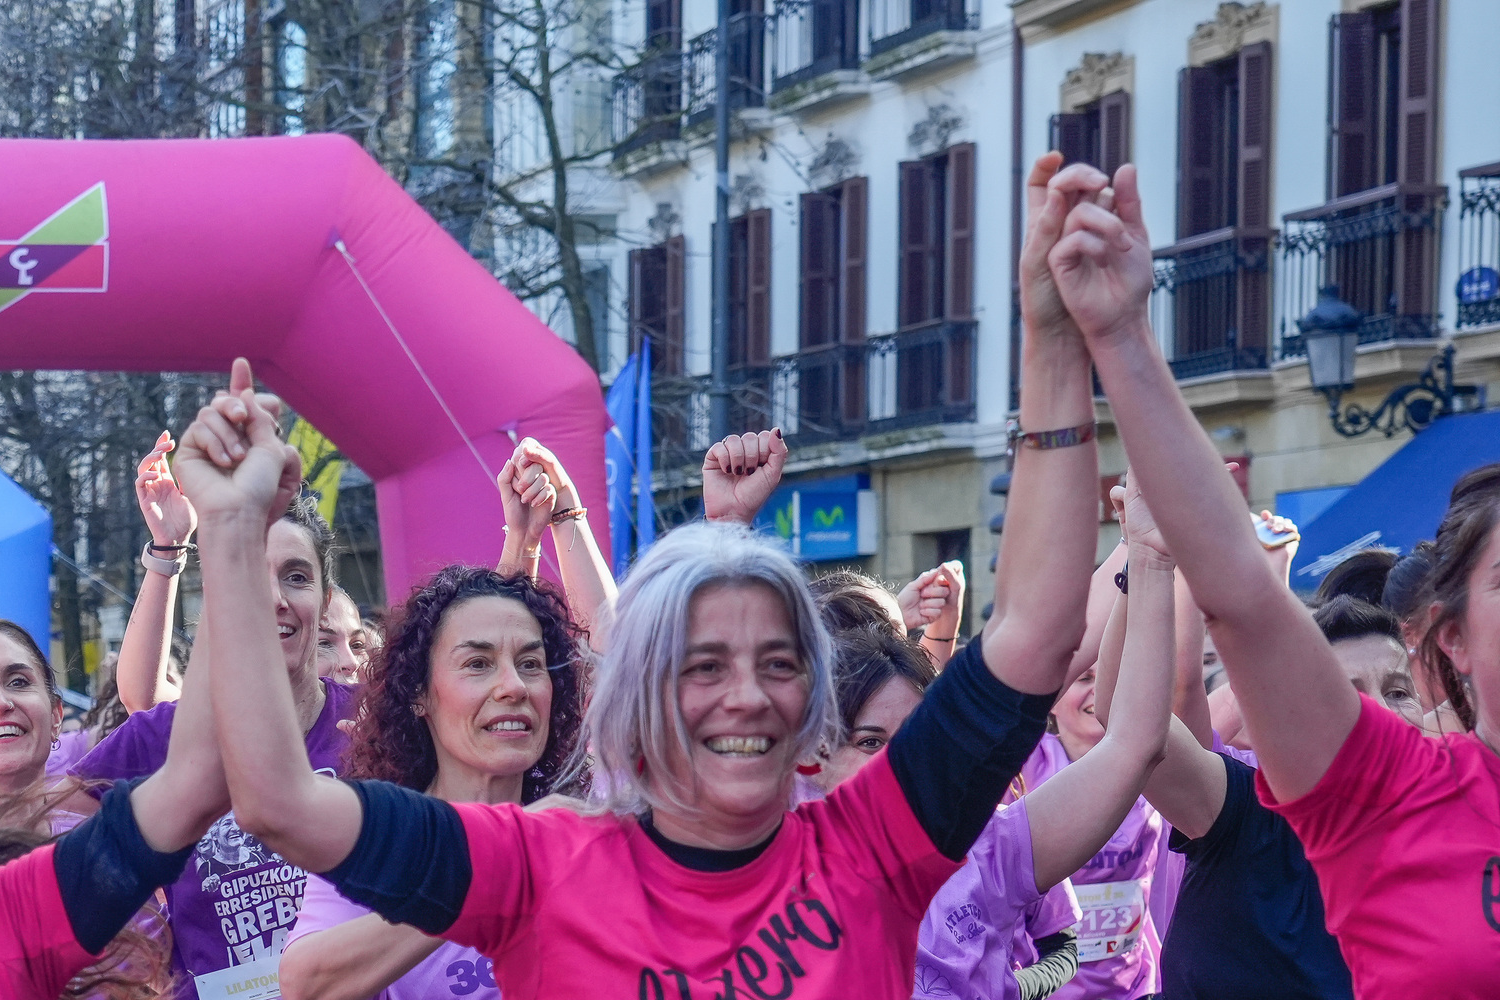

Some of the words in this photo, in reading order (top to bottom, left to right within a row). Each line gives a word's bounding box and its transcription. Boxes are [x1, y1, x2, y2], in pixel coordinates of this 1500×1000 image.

[214, 879, 308, 917] ERRESIDENT
[220, 865, 309, 898] GIPUZKOA
[225, 972, 280, 996] LILATON
